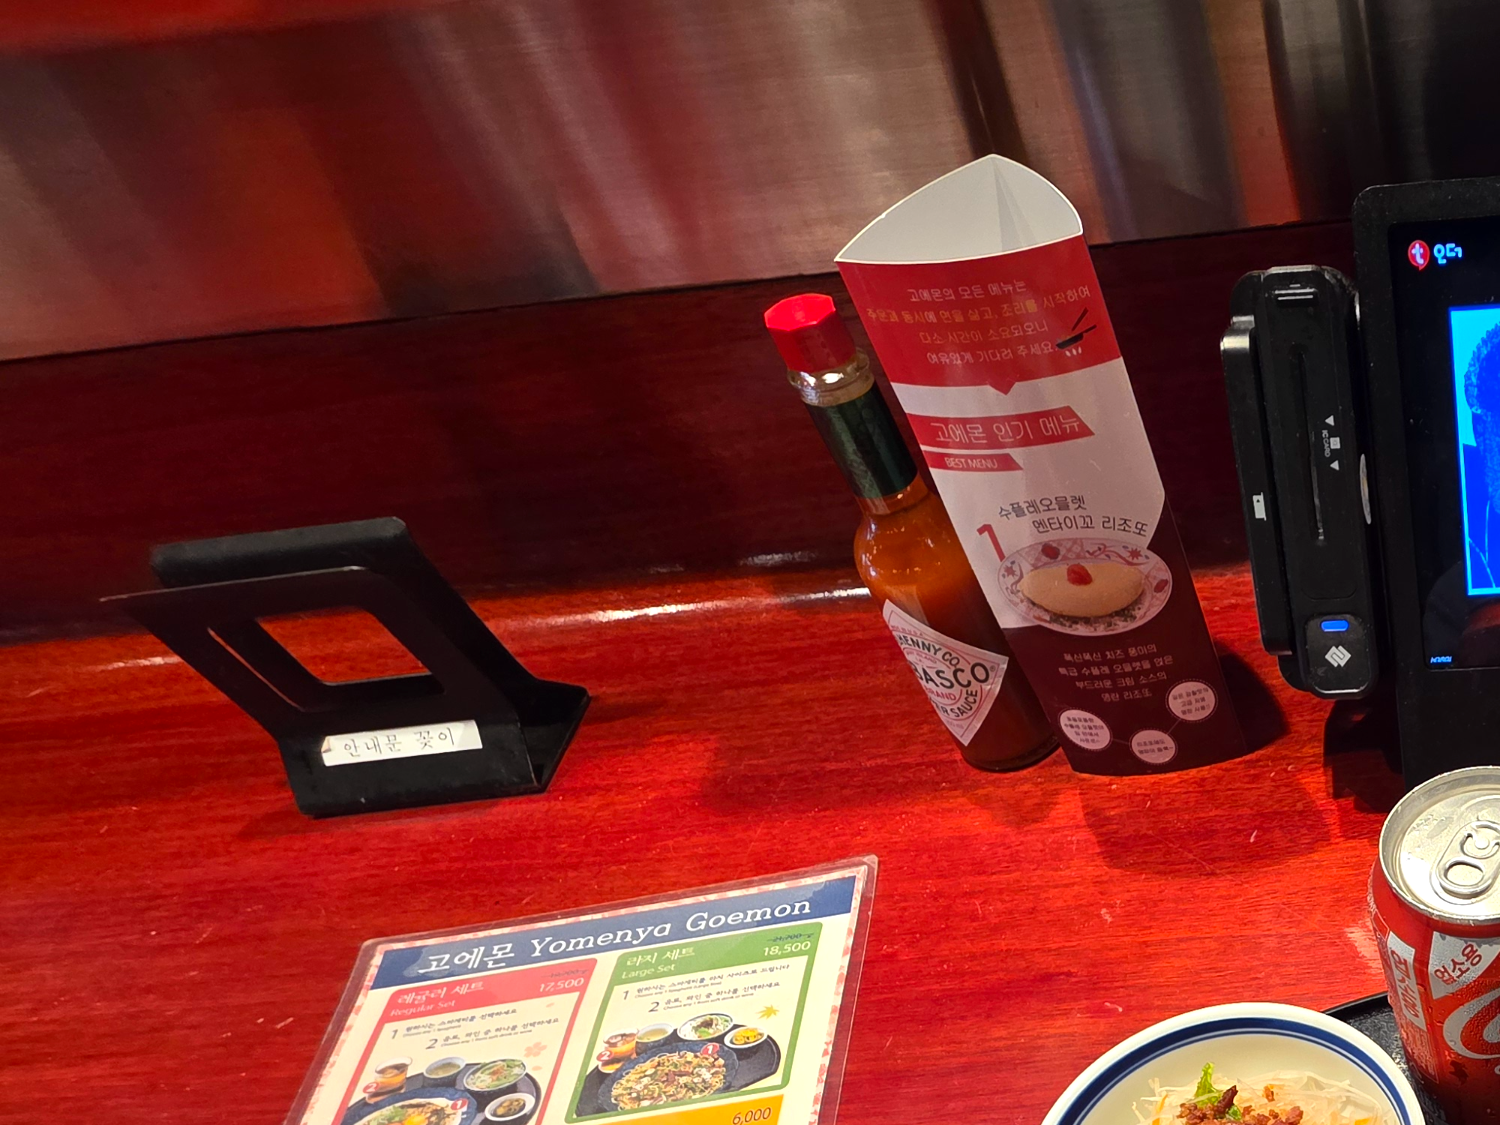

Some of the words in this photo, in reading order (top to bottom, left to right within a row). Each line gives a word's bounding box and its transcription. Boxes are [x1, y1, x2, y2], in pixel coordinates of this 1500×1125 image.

[907, 288, 955, 302] 고에몬의
[958, 285, 985, 300] 모든
[988, 279, 1027, 296] 메뉴는
[1042, 285, 1091, 308] 시작하여
[919, 332, 946, 344] 다소
[949, 331, 983, 344] 시간이
[987, 320, 1049, 342] 소요되오니
[978, 349, 1014, 362] 기다려
[930, 422, 987, 444] 고에몬
[992, 420, 1033, 442] 인기
[1040, 415, 1080, 437] 메뉴
[1322, 429, 1329, 438] IC
[945, 457, 967, 468] BEST
[968, 458, 998, 469] MENU
[998, 495, 1086, 521] 수플레오믈렛
[1101, 516, 1149, 538] 리조또
[976, 523, 1007, 563] 1
[1105, 650, 1125, 660] 치즈
[1076, 679, 1113, 690] 부드러운
[1139, 671, 1167, 683] 소스의
[1123, 688, 1153, 700] 리조또
[950, 689, 978, 718] SAUCE
[344, 735, 402, 758] 안내문
[418, 944, 515, 974] 고에몬
[530, 921, 672, 957] Yomenya
[686, 900, 811, 932] Goemon
[627, 952, 656, 967] 라지
[662, 947, 695, 961] 세트
[764, 941, 811, 956] 18,500
[622, 967, 655, 980] Large
[657, 963, 675, 974] Set
[1434, 944, 1483, 987] 업소용
[451, 980, 484, 995] 세트
[623, 990, 630, 1000] 1
[390, 1002, 435, 1017] Regular
[437, 1000, 456, 1009] Set
[648, 1001, 660, 1012] 2
[391, 1029, 398, 1039] 1
[425, 1038, 438, 1049] 2
